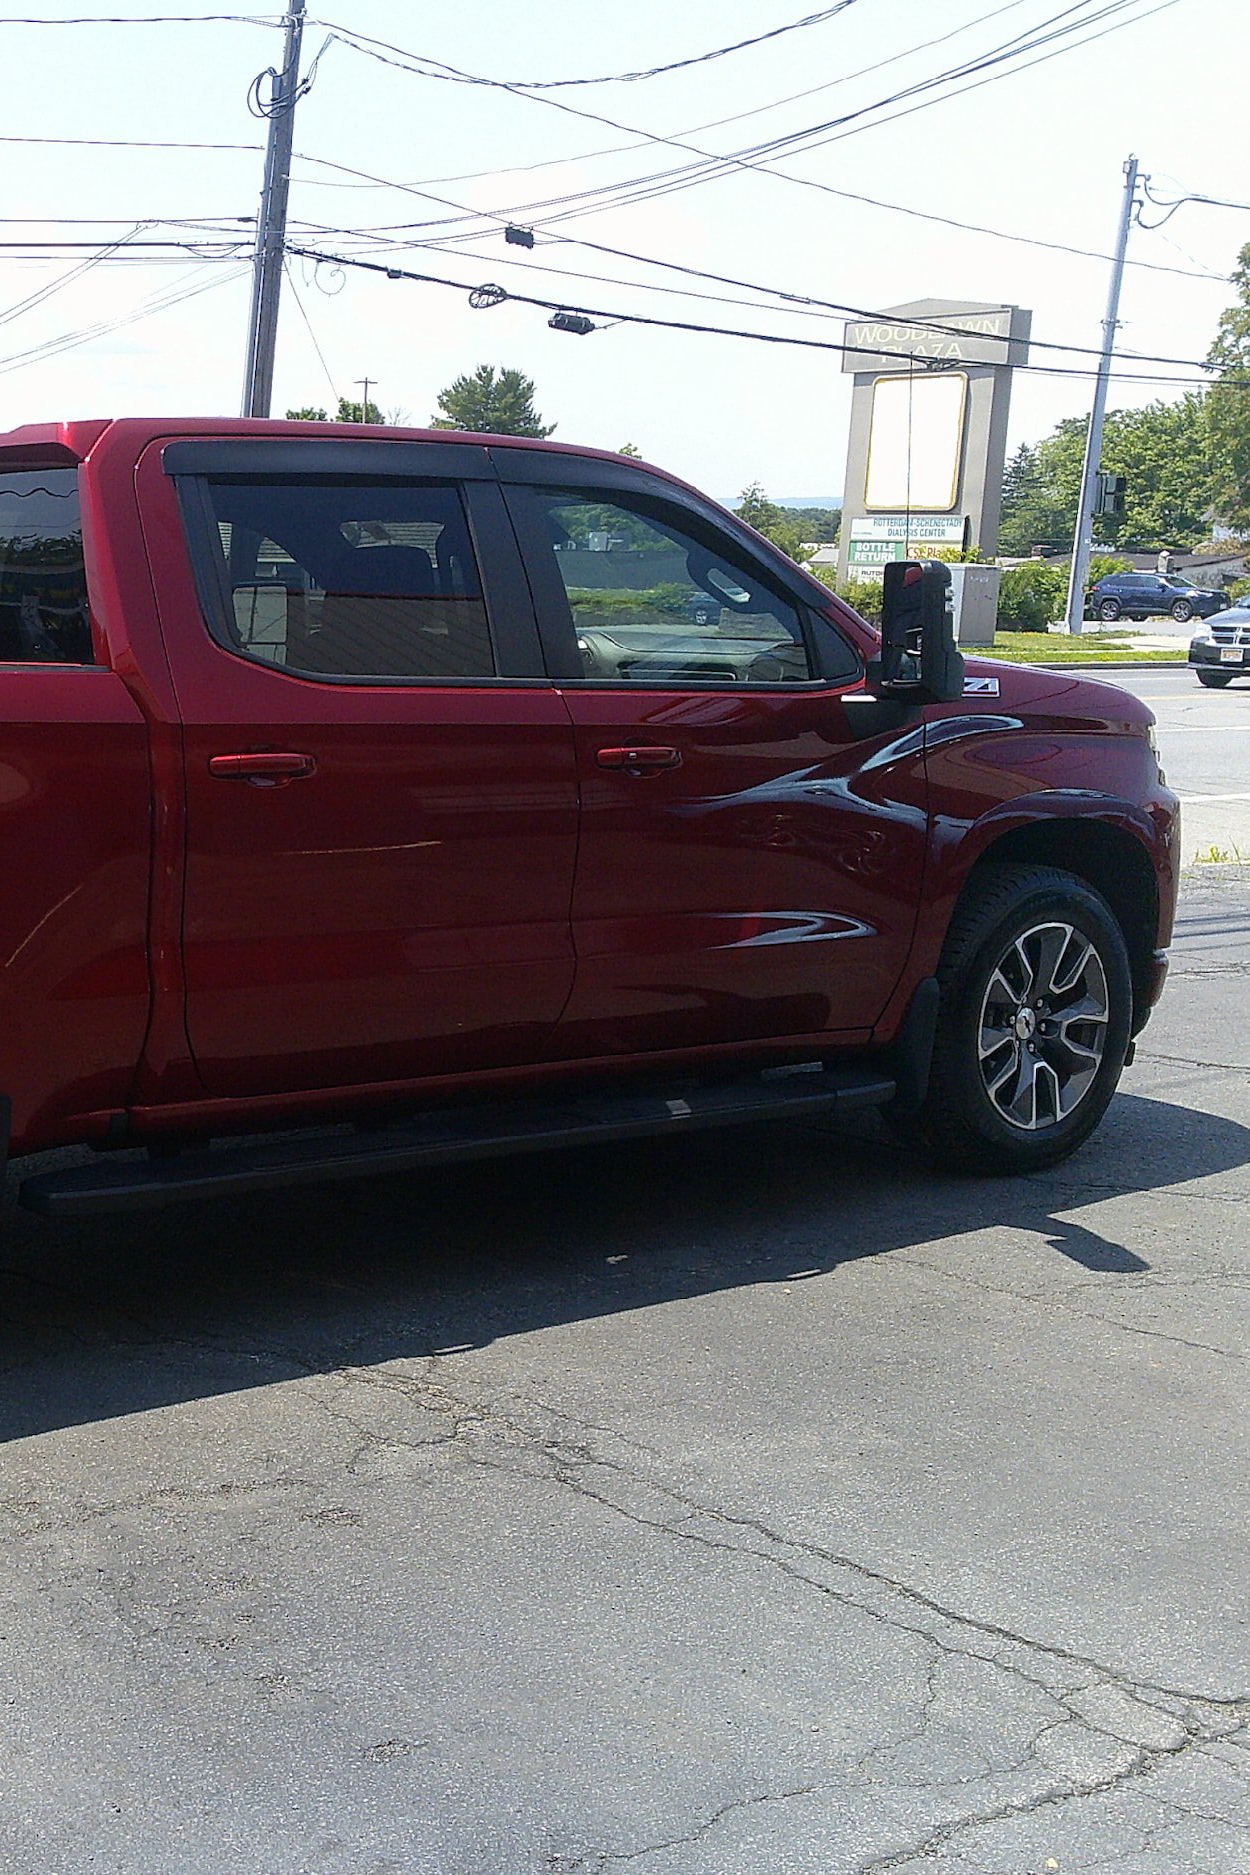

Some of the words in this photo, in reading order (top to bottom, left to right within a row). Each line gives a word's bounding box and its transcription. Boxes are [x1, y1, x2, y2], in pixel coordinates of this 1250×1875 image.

[880, 341, 963, 363] PLAZA
[919, 528, 946, 537] CENTER
[855, 541, 896, 552] BOTTLE
[854, 551, 896, 561] RETURN
